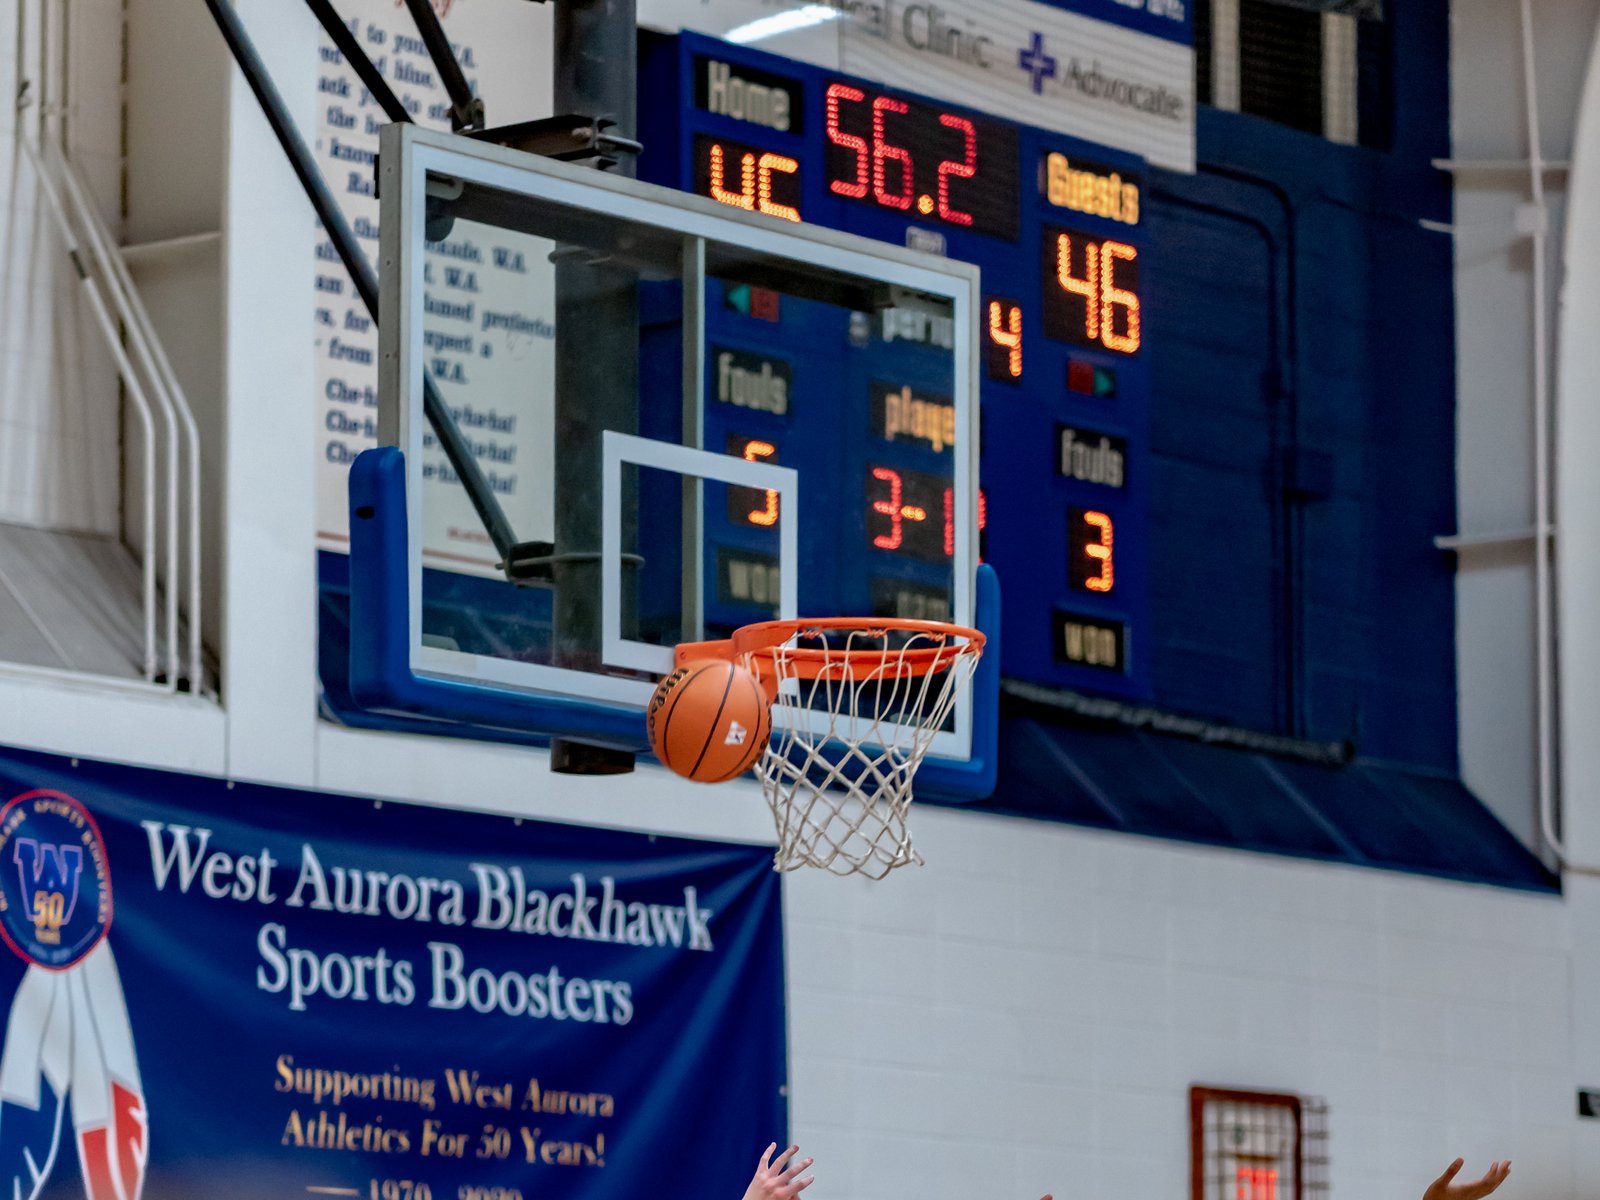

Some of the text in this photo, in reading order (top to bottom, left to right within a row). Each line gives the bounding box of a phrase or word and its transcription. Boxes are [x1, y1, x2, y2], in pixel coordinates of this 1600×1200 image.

[903, 5, 994, 70] Clinic
[708, 60, 790, 131] Home
[1063, 57, 1183, 120] Advocate
[826, 83, 977, 226] 56.2
[1047, 152, 1139, 225] Guests
[1055, 232, 1141, 354] 46
[988, 300, 1024, 377] 4
[1083, 509, 1114, 592] 3
[34, 889, 65, 929] 50
[141, 820, 714, 952] West Aurora Blackhawk
[257, 922, 634, 1025] Sports Boosters
[274, 1054, 615, 1118] Supporting West Aurora
[281, 1109, 606, 1167] Athletics For 50 Years!
